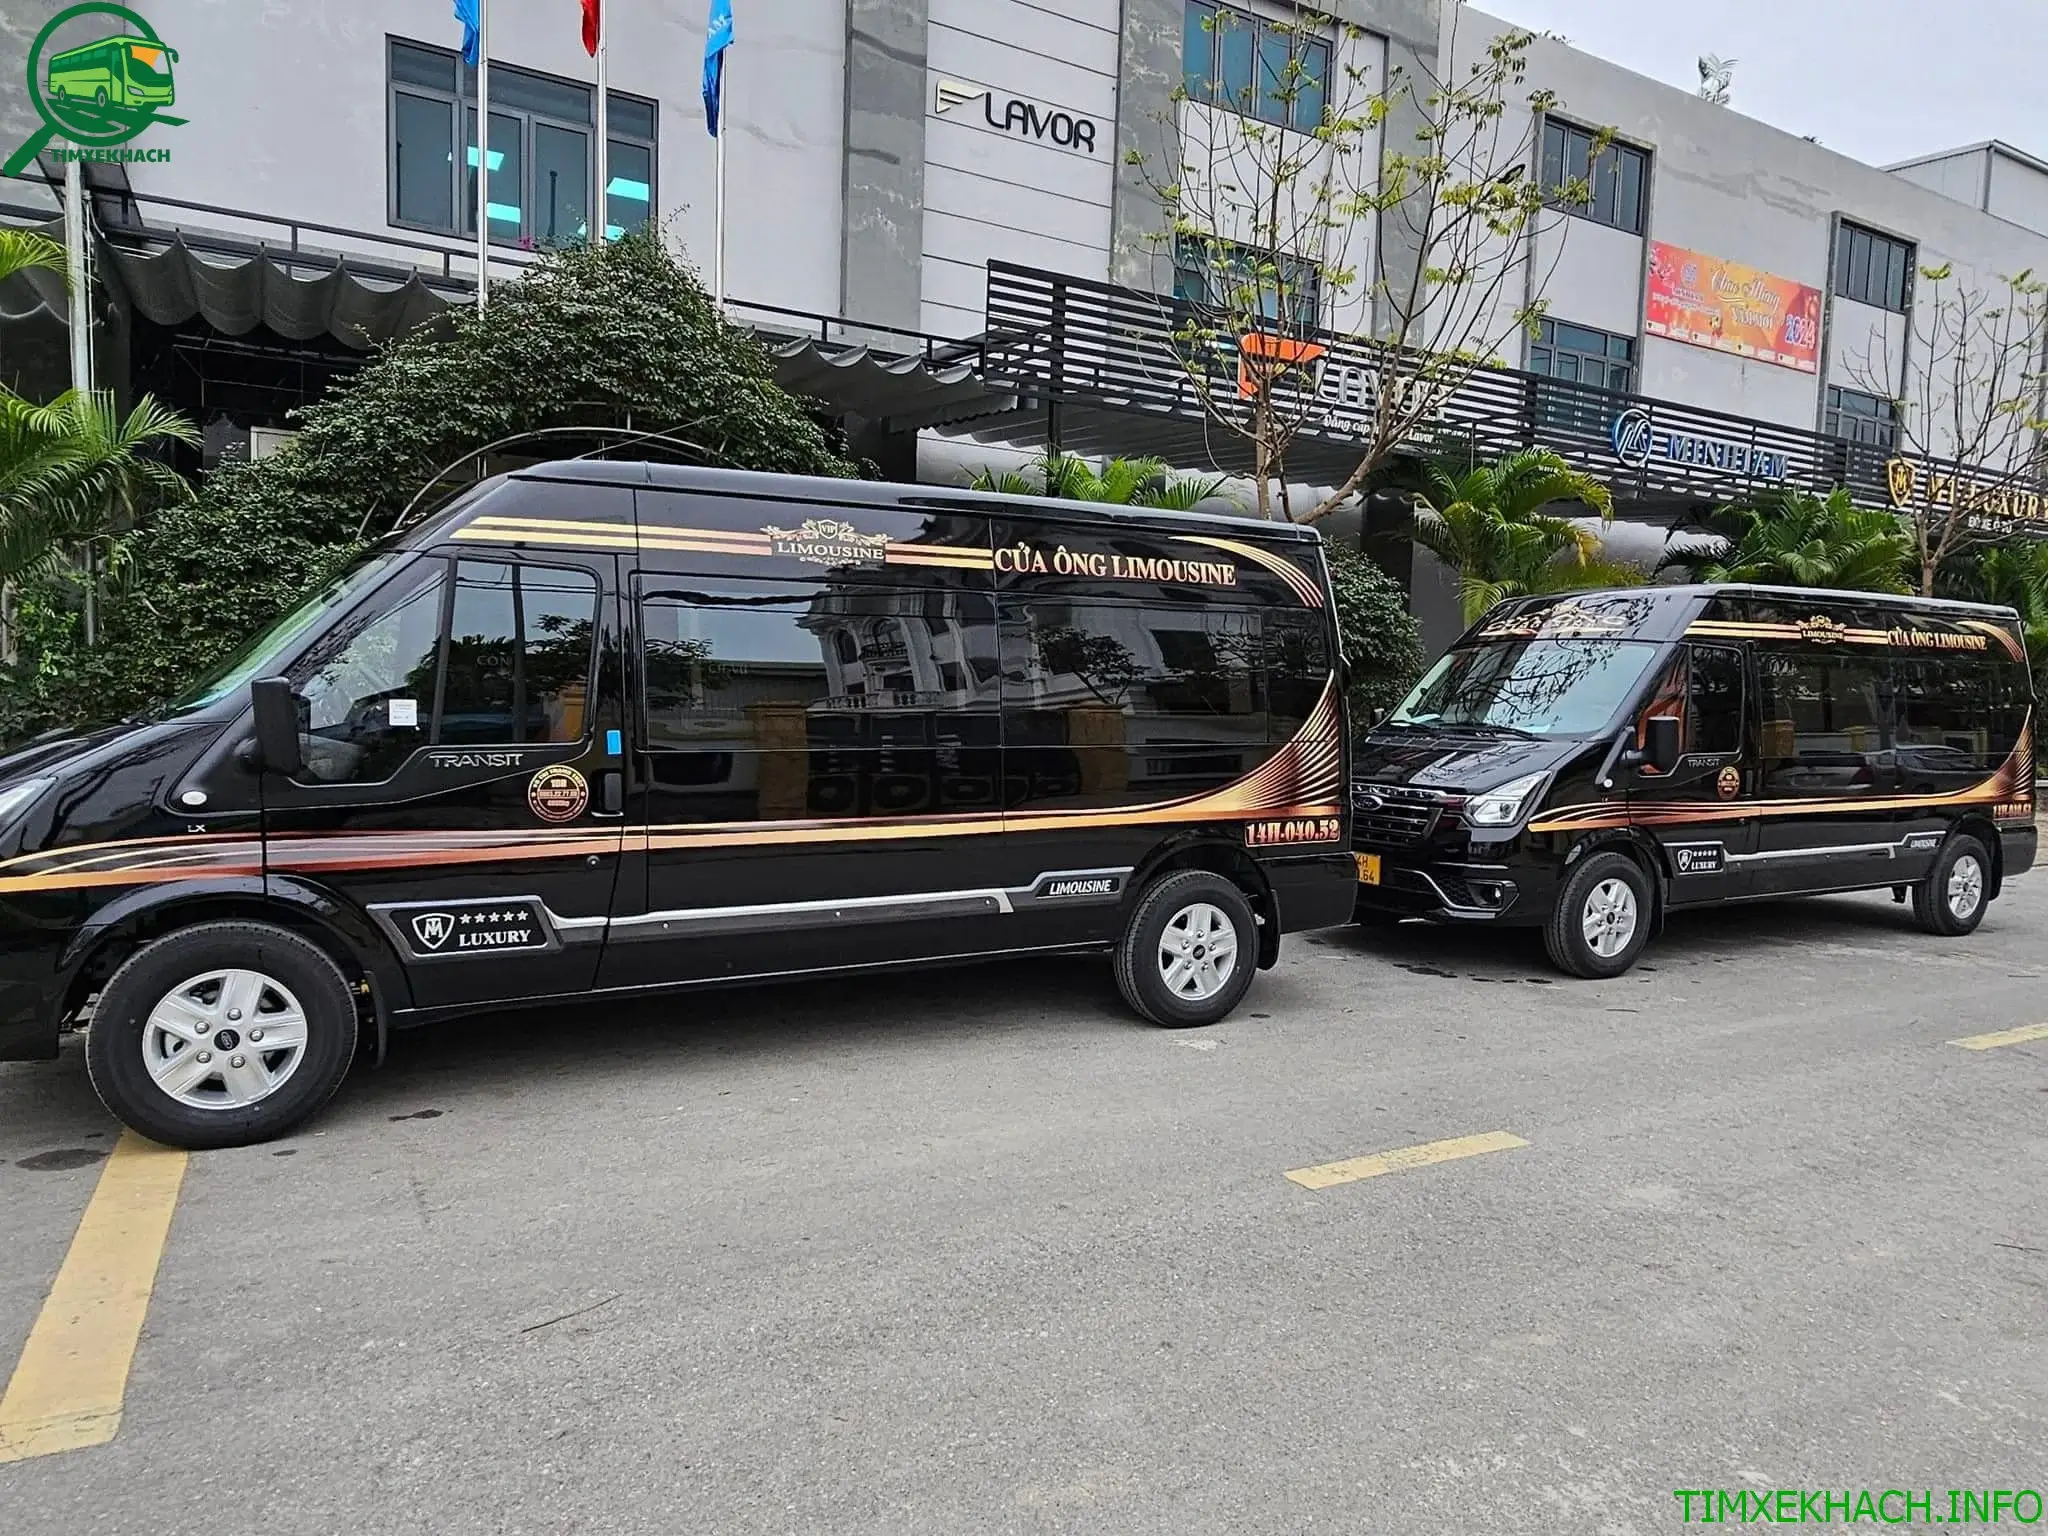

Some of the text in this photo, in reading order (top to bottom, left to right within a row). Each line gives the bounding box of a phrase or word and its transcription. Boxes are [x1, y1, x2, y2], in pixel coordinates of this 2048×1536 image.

[1785, 314, 1816, 350] 2024
[777, 542, 885, 560] LIMOUSINE
[995, 541, 1237, 586] CỬA ÔNG LIMOUSINE
[1802, 630, 1845, 640] LIMOUSINE
[1935, 631, 1987, 651] LIMOUSINE
[429, 753, 523, 768] TRANSIT
[1687, 758, 1720, 768] TRANSIT
[187, 824, 206, 833] LX
[1049, 879, 1112, 896] LIMOUSINE
[458, 929, 532, 947] LUXURY
